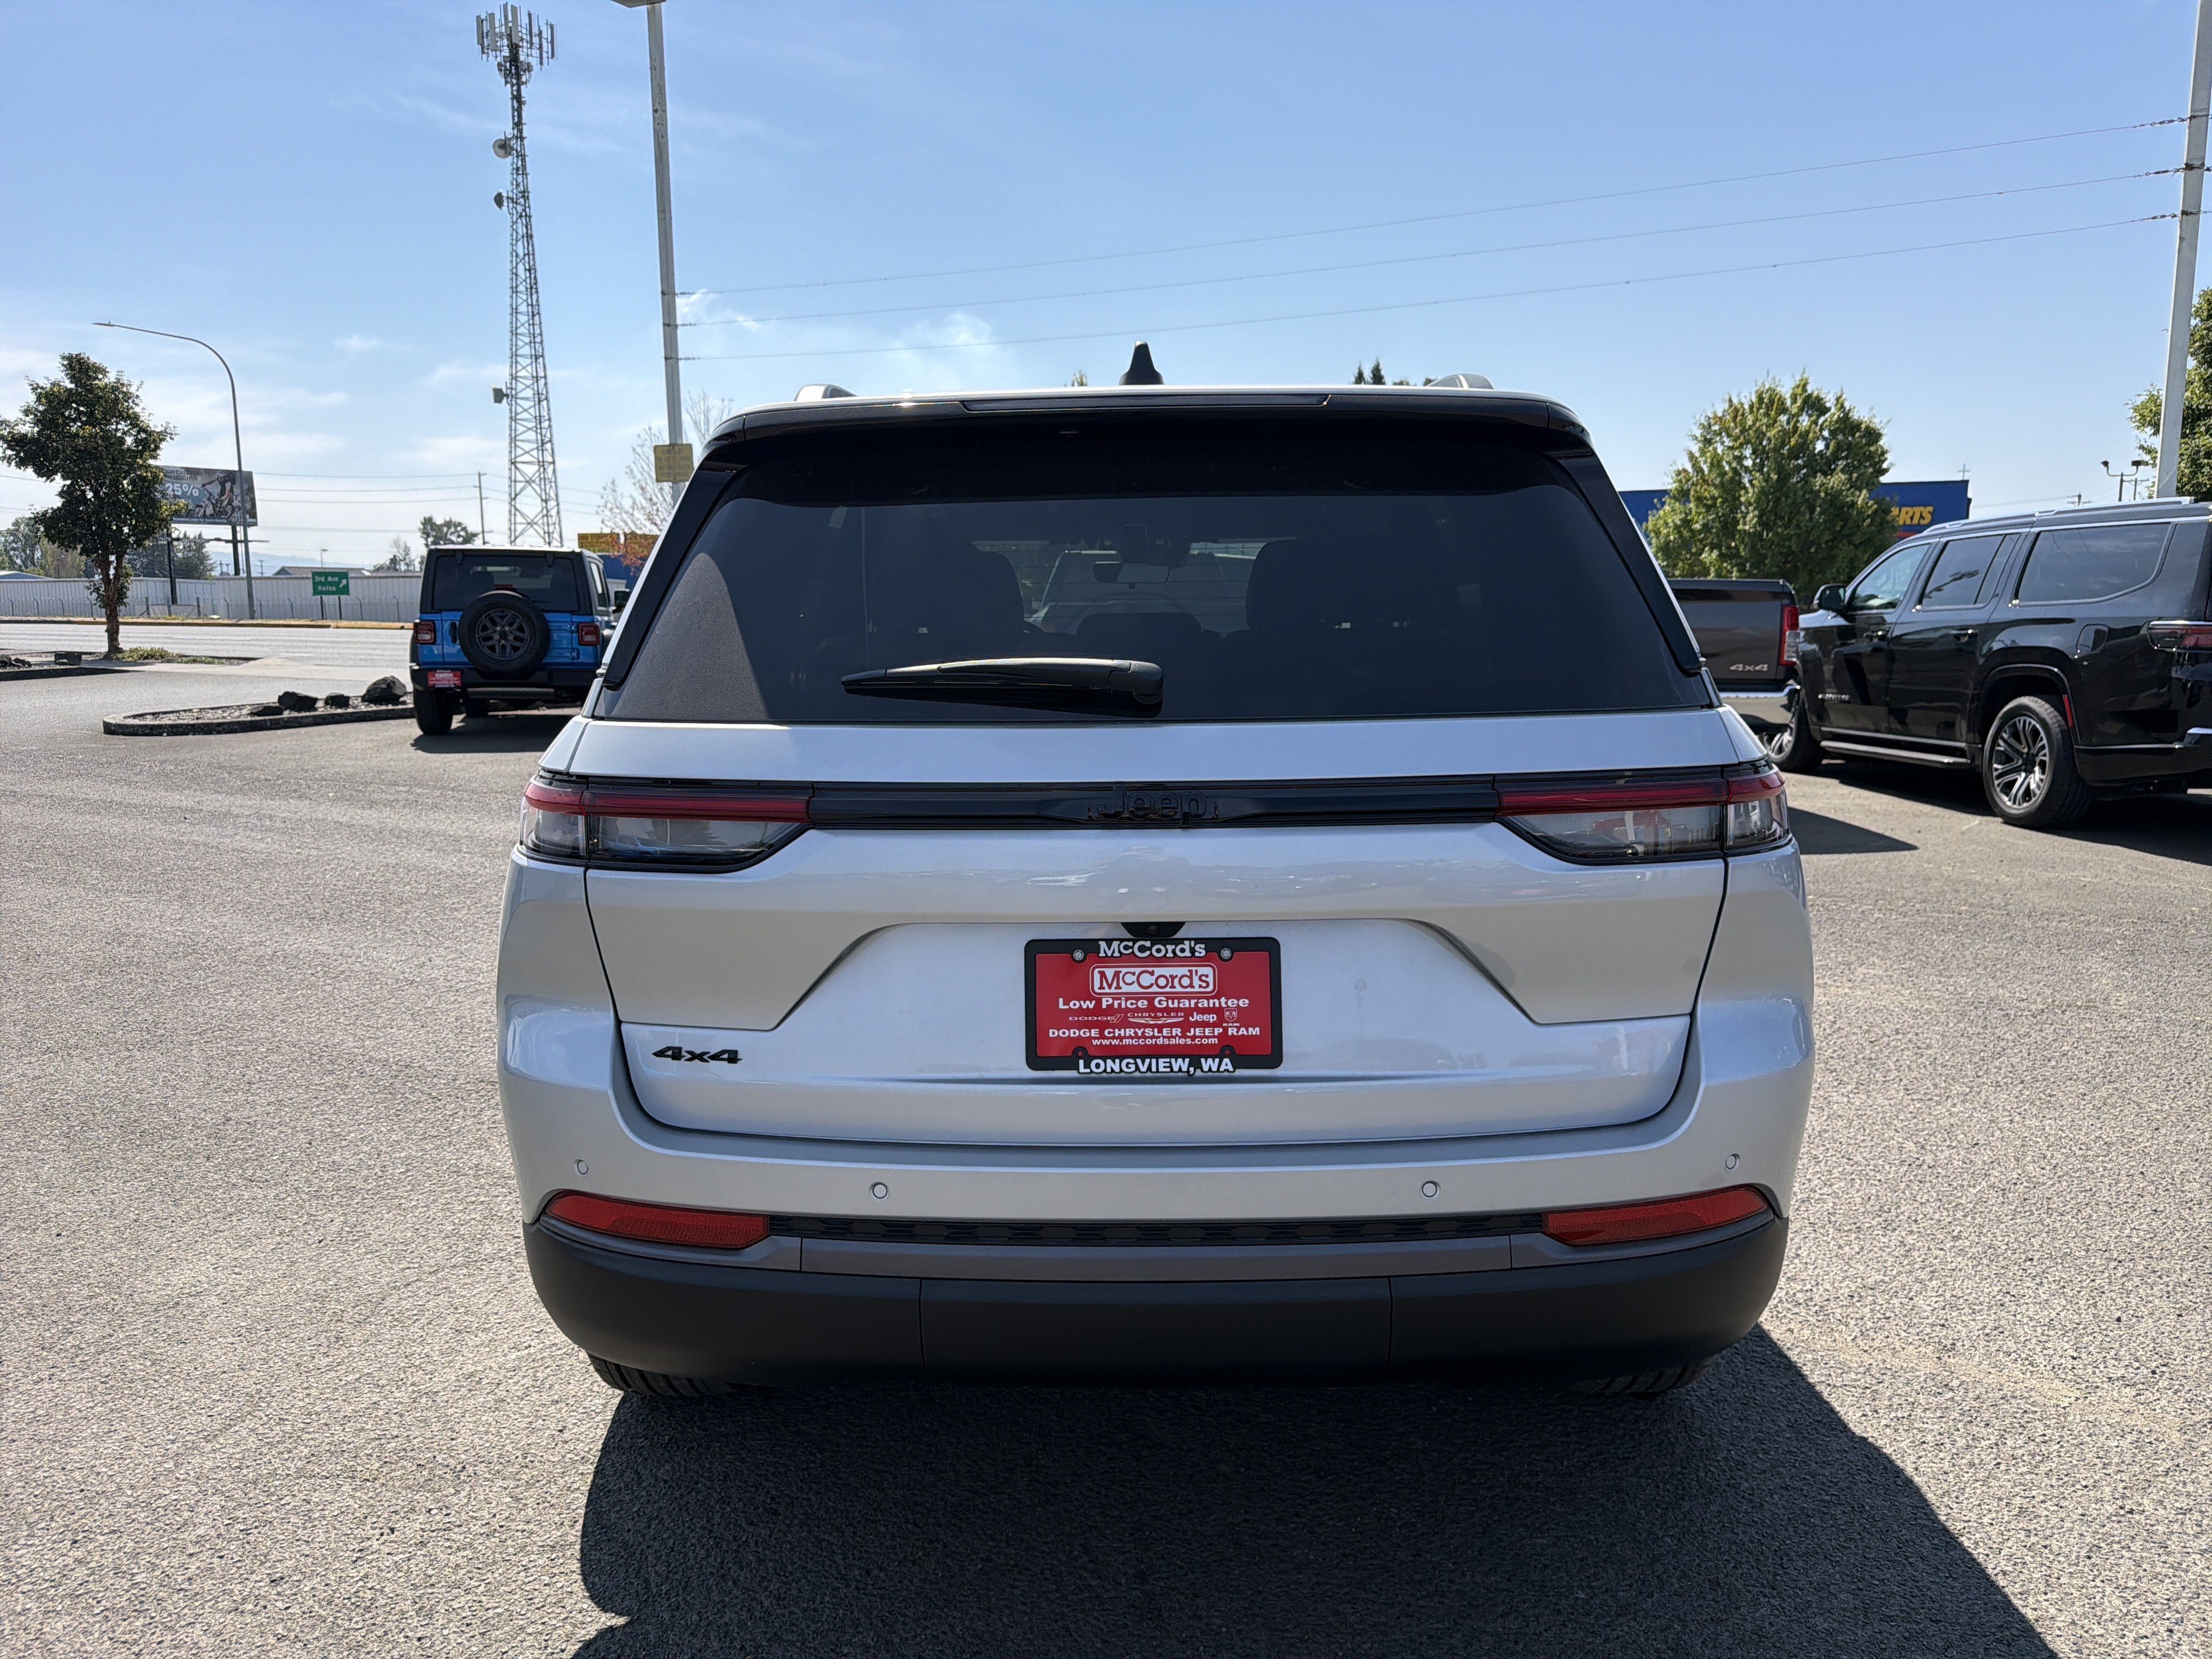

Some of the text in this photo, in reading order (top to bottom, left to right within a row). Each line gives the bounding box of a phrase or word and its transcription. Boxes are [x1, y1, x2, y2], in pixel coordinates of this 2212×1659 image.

[165, 483, 199, 496] 25%
[1889, 506, 1933, 525] ARTS
[1729, 663, 1768, 672] 4x4
[1097, 785, 1207, 827] Jeep
[1098, 940, 1206, 957] McCord's
[1098, 969, 1210, 990] McCord's
[1059, 996, 1249, 1009] Low Price Guarantee
[1189, 1012, 1217, 1023] Jeep
[1049, 1027, 1260, 1037] DODGE CHRYSLER JEEP RAM
[1092, 1036, 1218, 1045] www.mccordsales.com
[652, 1046, 743, 1064] 4x4
[1079, 1058, 1234, 1074] LONGVIEW, WA
